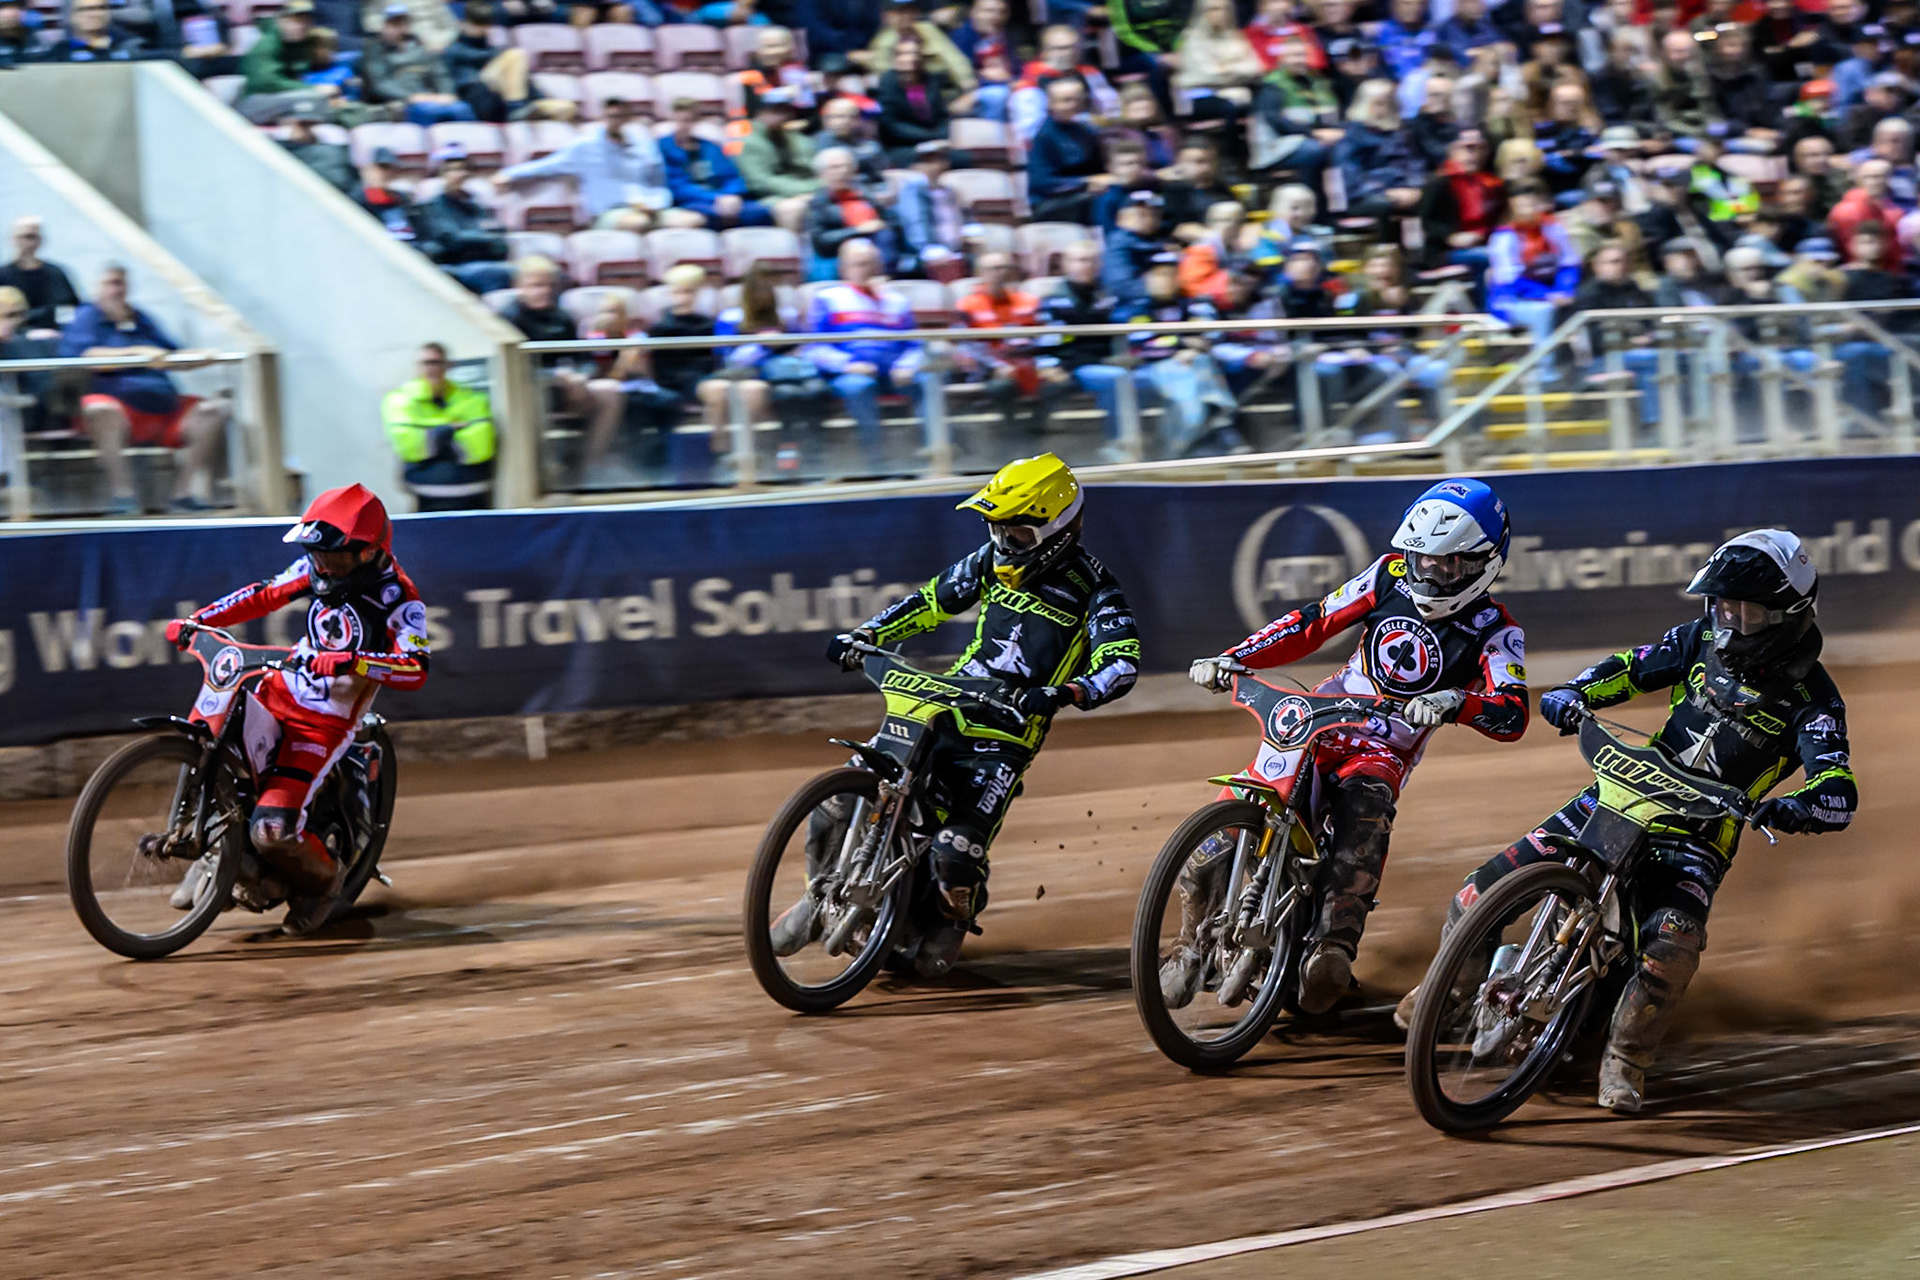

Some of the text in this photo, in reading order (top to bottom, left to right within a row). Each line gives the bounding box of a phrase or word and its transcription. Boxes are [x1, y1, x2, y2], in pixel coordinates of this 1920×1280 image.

[466, 577, 677, 649] Travel
[1381, 621, 1439, 669] BELLE VUE ACES
[882, 670, 931, 693] tru7
[1593, 745, 1661, 784] tru7
